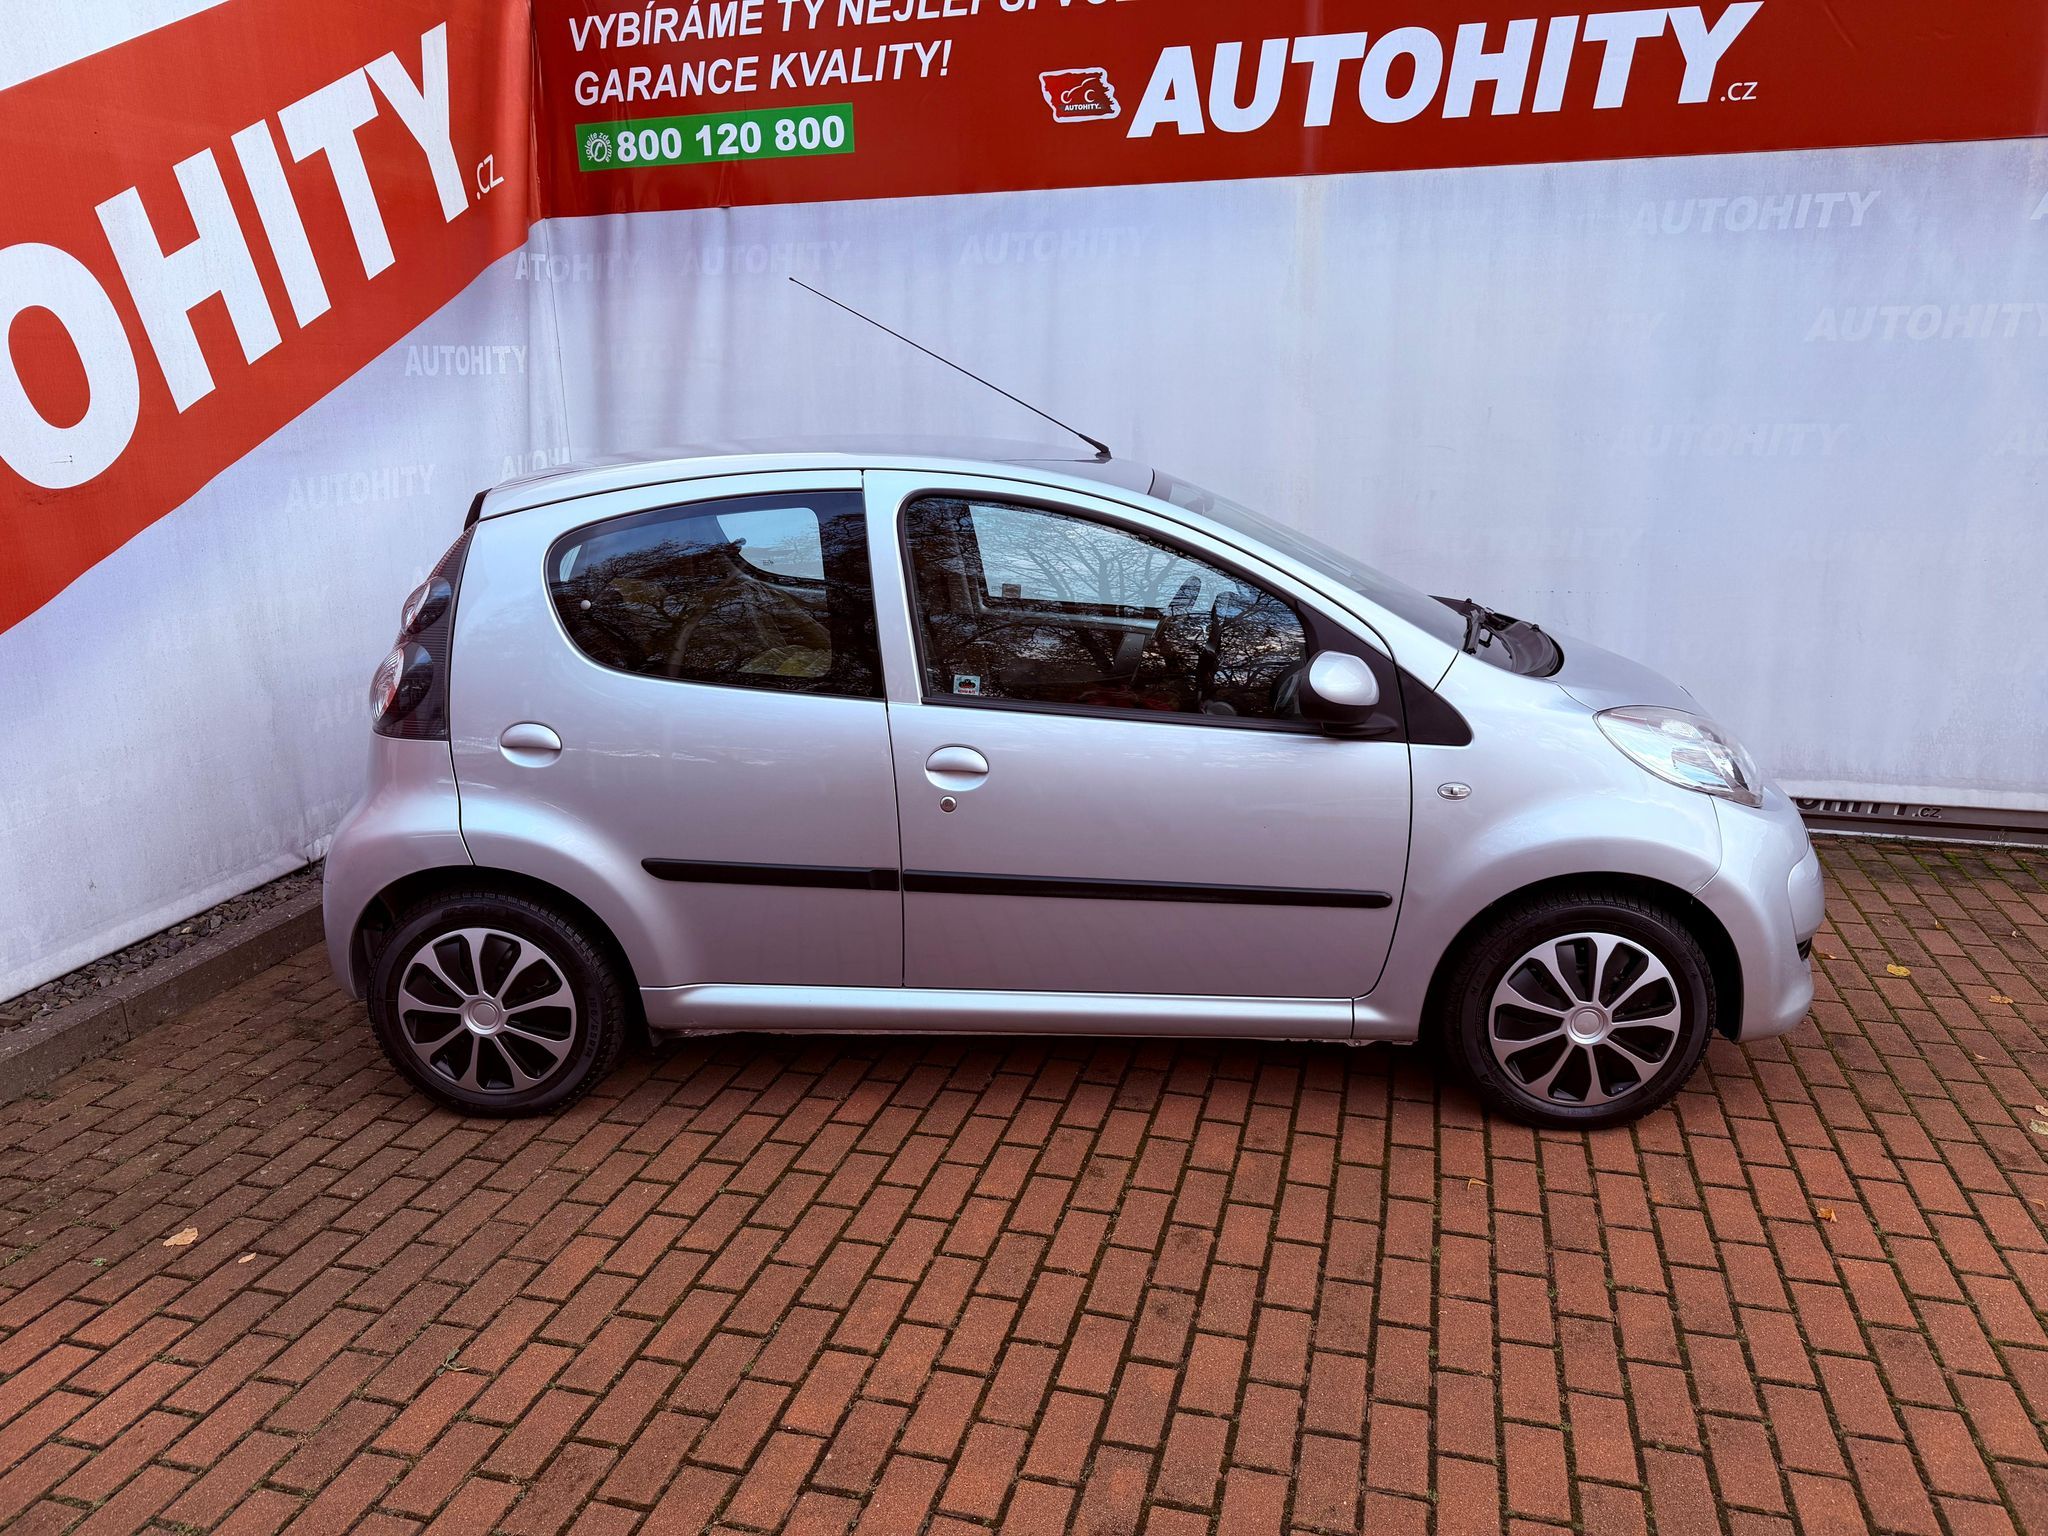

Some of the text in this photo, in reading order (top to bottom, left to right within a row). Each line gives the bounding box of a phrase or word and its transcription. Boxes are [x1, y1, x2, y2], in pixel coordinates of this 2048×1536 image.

[569, 0, 1037, 51] VYBÍRÁME TY NEJLE
[575, 40, 952, 106] GARANCE KVALITY!
[1127, 1, 1763, 138] AUTOHITY
[617, 115, 845, 163] 800 120 800
[1636, 190, 1882, 236] AUTOHITY
[958, 225, 1145, 266] AUTOHITY
[404, 344, 528, 377] AUTOHITY
[285, 462, 437, 512] AUTOHITY
